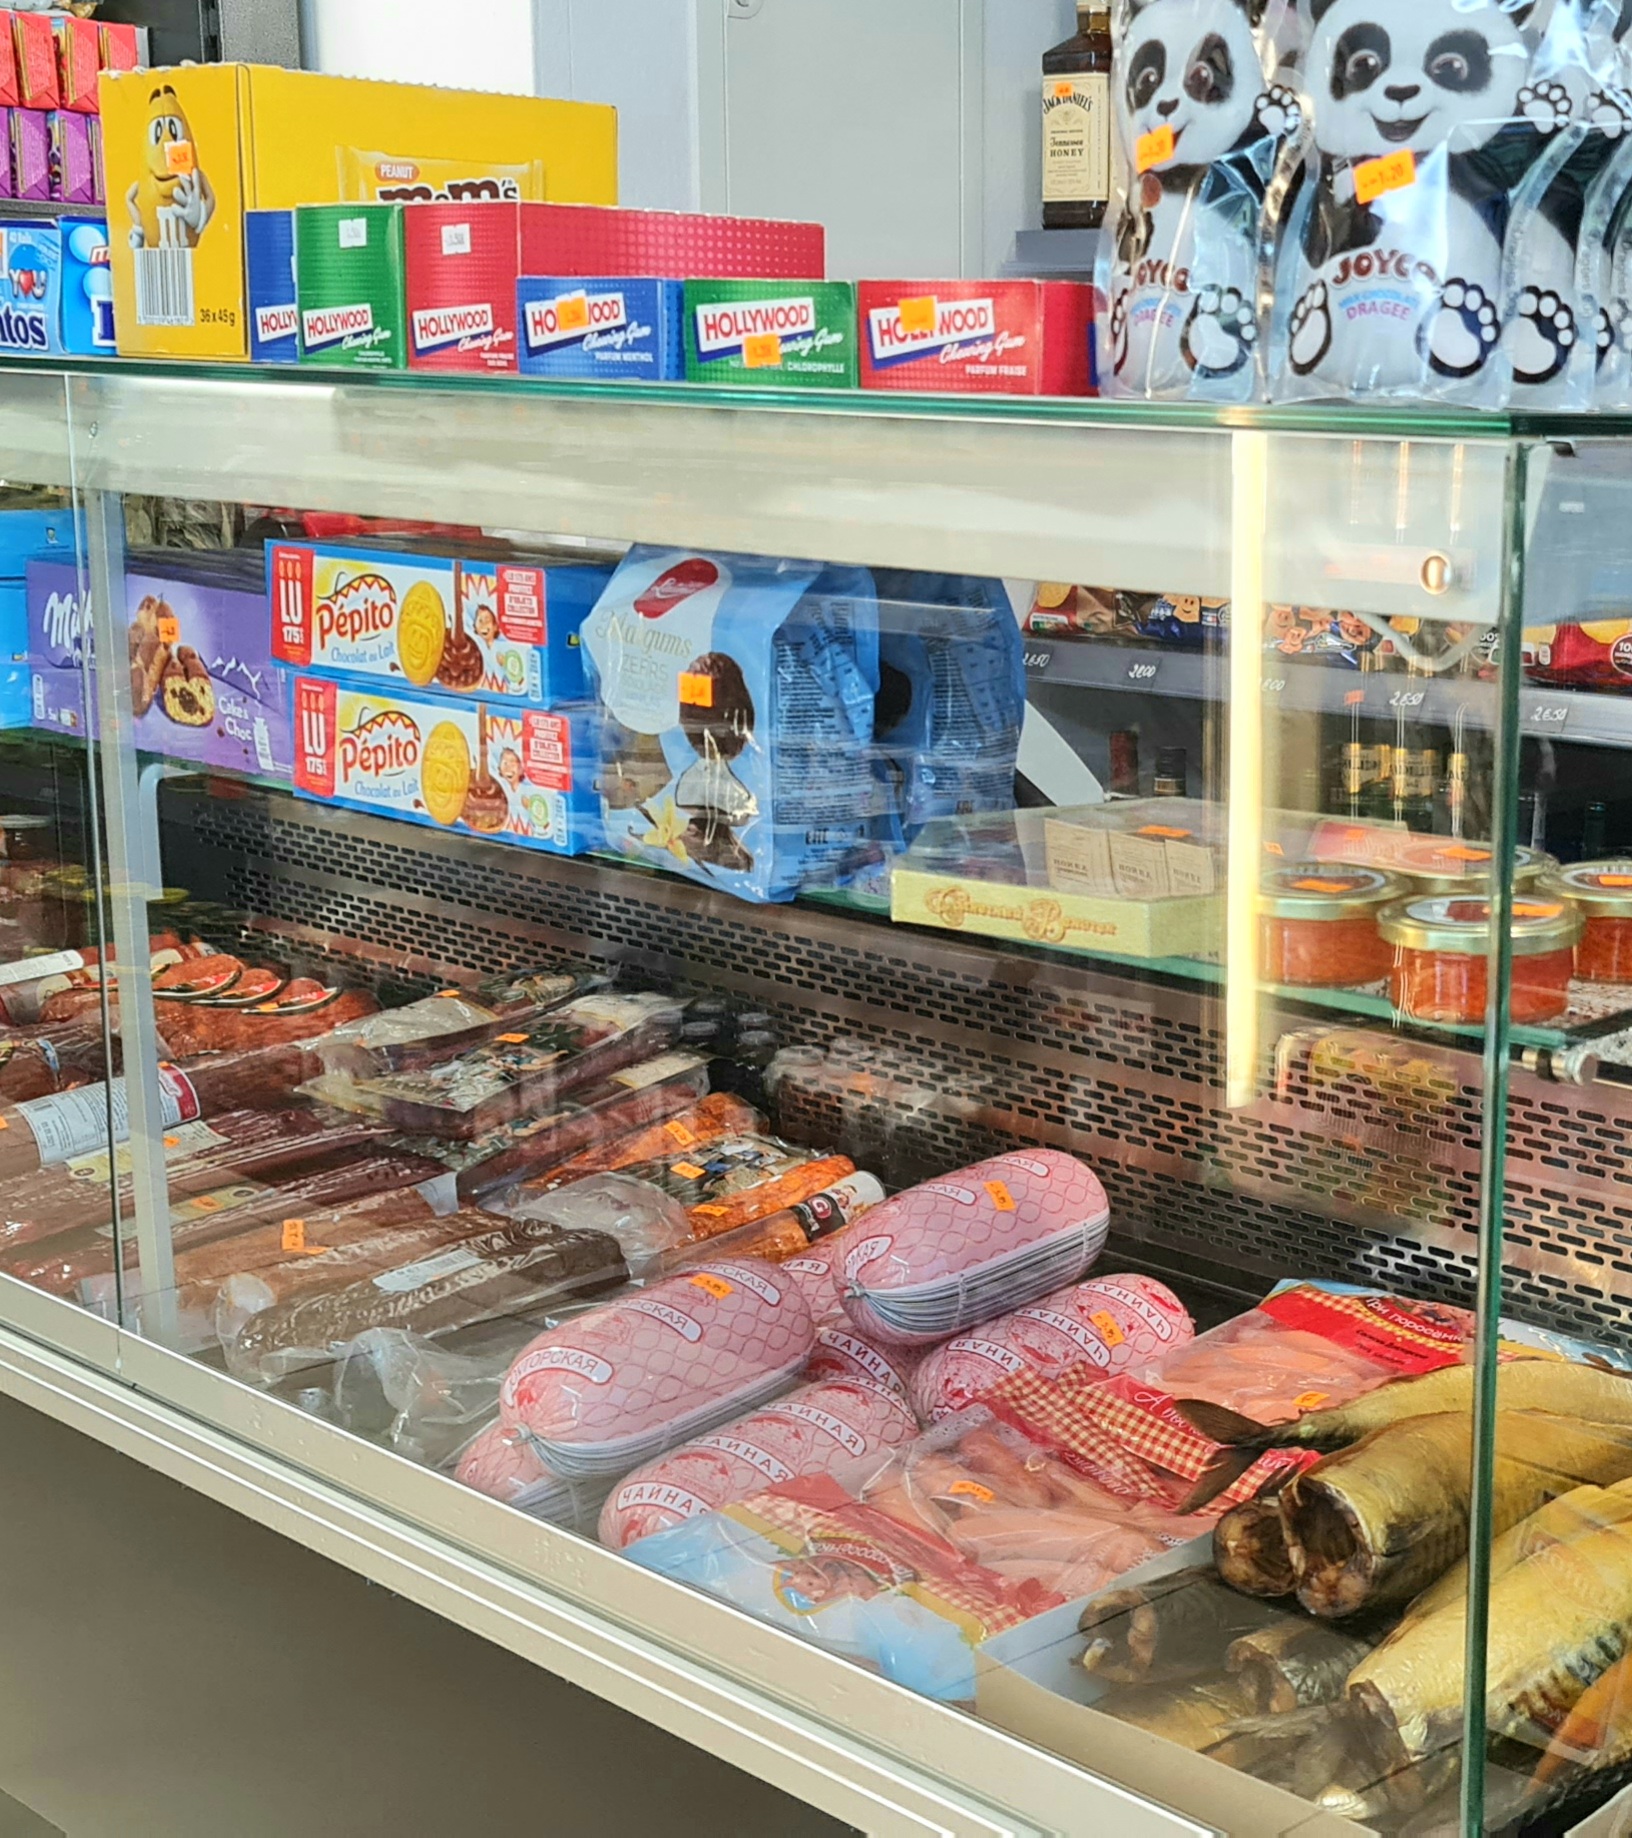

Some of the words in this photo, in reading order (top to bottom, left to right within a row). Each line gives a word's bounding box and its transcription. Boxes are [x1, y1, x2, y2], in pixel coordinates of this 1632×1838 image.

[1050, 148, 1084, 157] HONEY
[380, 164, 414, 179] PEANUT
[531, 300, 620, 336] HOOOD
[1346, 300, 1411, 321] DRAGEE
[307, 310, 369, 338] HOLLYWOOD
[418, 310, 488, 340] HOLLYWOOD
[704, 305, 810, 341] HOLLYWOOD
[342, 331, 373, 349] Chewing
[373, 327, 392, 344] Gum
[458, 333, 494, 351] Chewing
[493, 328, 514, 347] Gum
[582, 331, 627, 351] Chewing
[626, 321, 651, 339] Gum
[814, 327, 844, 346] Gum
[939, 341, 993, 364] Chewing
[994, 331, 1026, 356] Gum
[621, 352, 653, 363] MENTHOL
[787, 361, 845, 373] CHLOROPHYLLE
[965, 365, 997, 376] PARFUM
[999, 365, 1027, 376] FRAISE
[280, 579, 303, 625] LU
[316, 601, 394, 650] Pépito
[331, 646, 367, 664] Chocolat
[368, 653, 378, 662] au
[378, 644, 394, 659] Lait
[219, 697, 249, 719] Cakes
[224, 718, 253, 741] Choc
[303, 710, 326, 756] LU
[339, 735, 418, 783] Pépito
[355, 780, 391, 797] Chocolat
[402, 778, 418, 797] Lait
